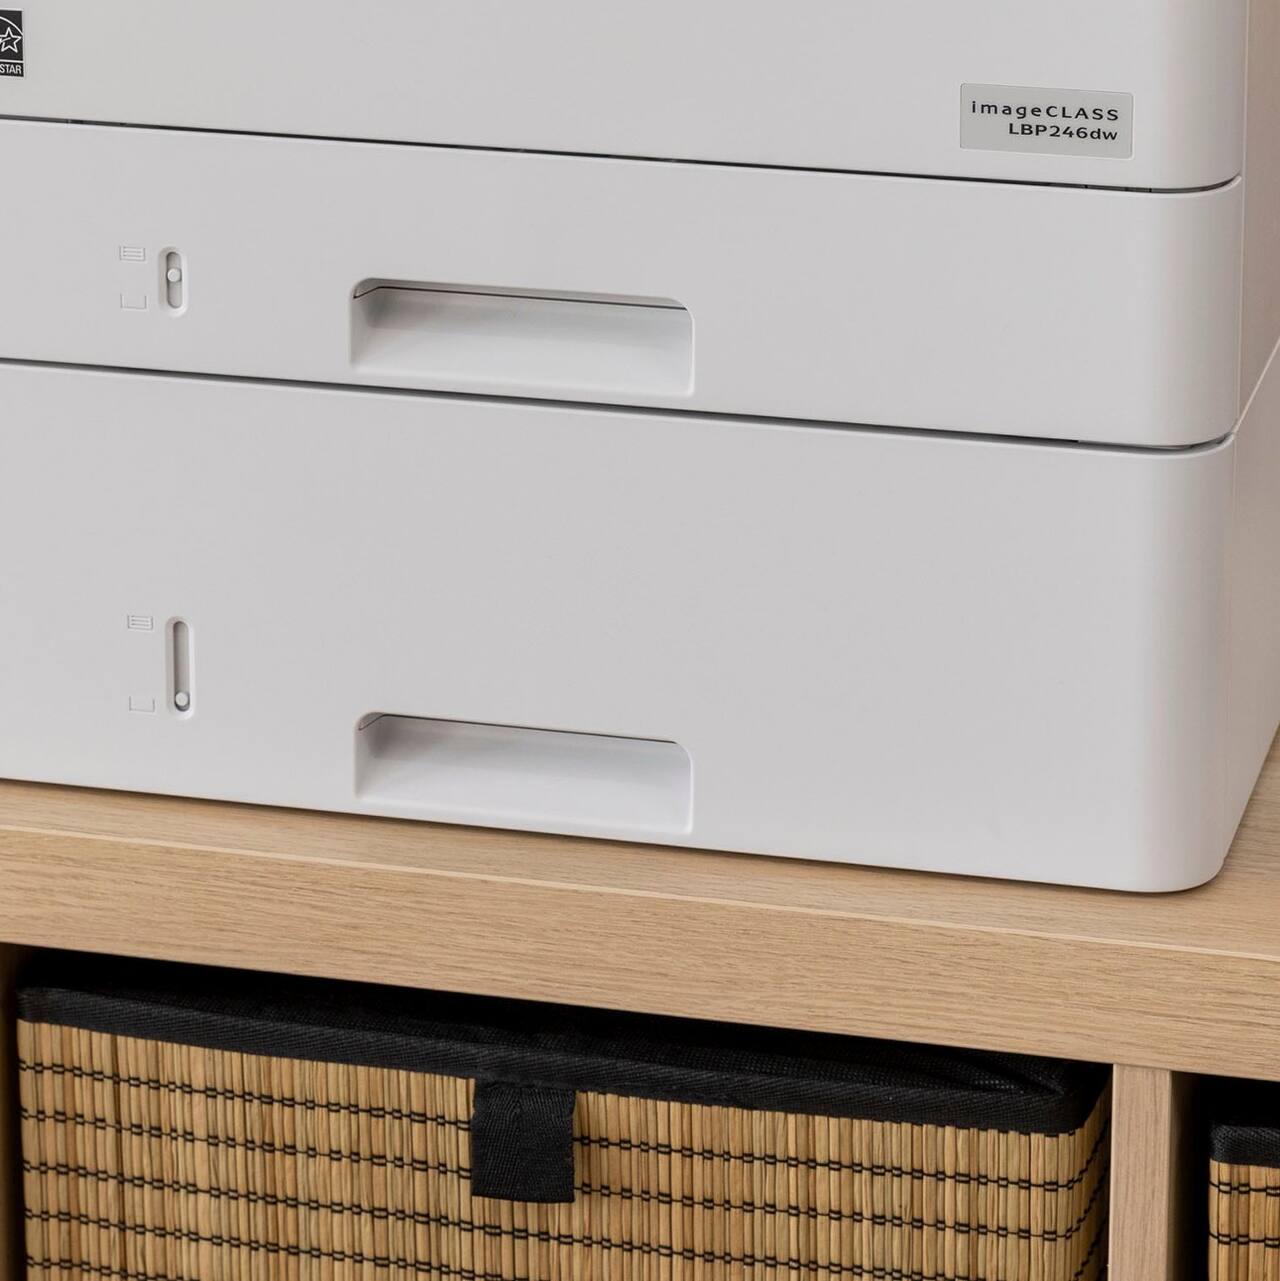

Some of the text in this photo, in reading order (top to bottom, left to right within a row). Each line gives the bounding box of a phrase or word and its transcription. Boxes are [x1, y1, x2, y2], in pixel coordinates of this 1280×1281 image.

[0, 63, 22, 75] STAR
[971, 100, 1119, 122] imageCLASS
[1008, 122, 1118, 141] LBP246dw
